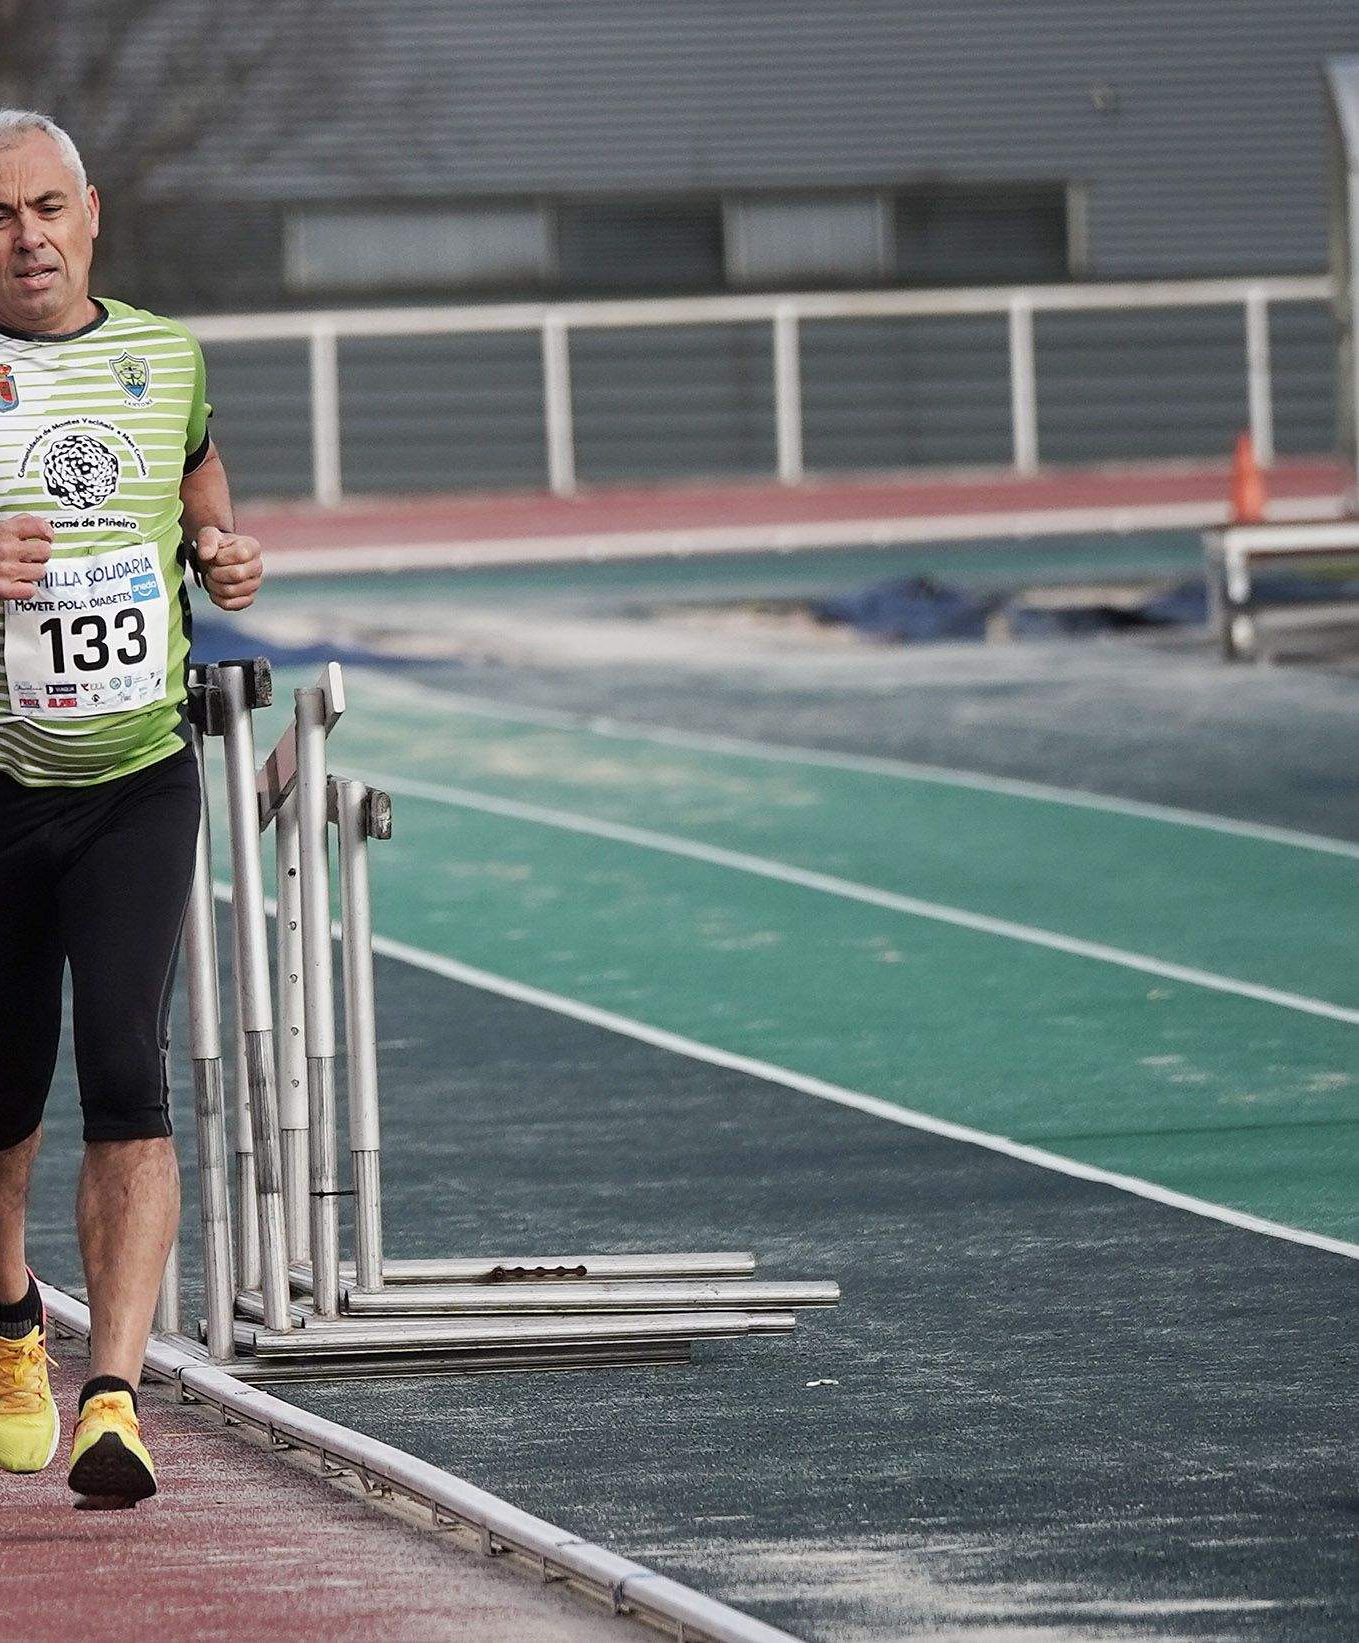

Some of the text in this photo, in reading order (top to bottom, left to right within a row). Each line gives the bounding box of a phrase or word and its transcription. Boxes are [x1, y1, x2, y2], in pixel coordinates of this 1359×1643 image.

[43, 428, 52, 436] de
[51, 419, 80, 430] Montes
[82, 517, 95, 528] de
[98, 517, 137, 529] Piñeiro
[85, 556, 153, 587] SOLIDARIA
[57, 600, 87, 611] POLA
[89, 591, 132, 608] DIABETES
[40, 607, 148, 674] 133
